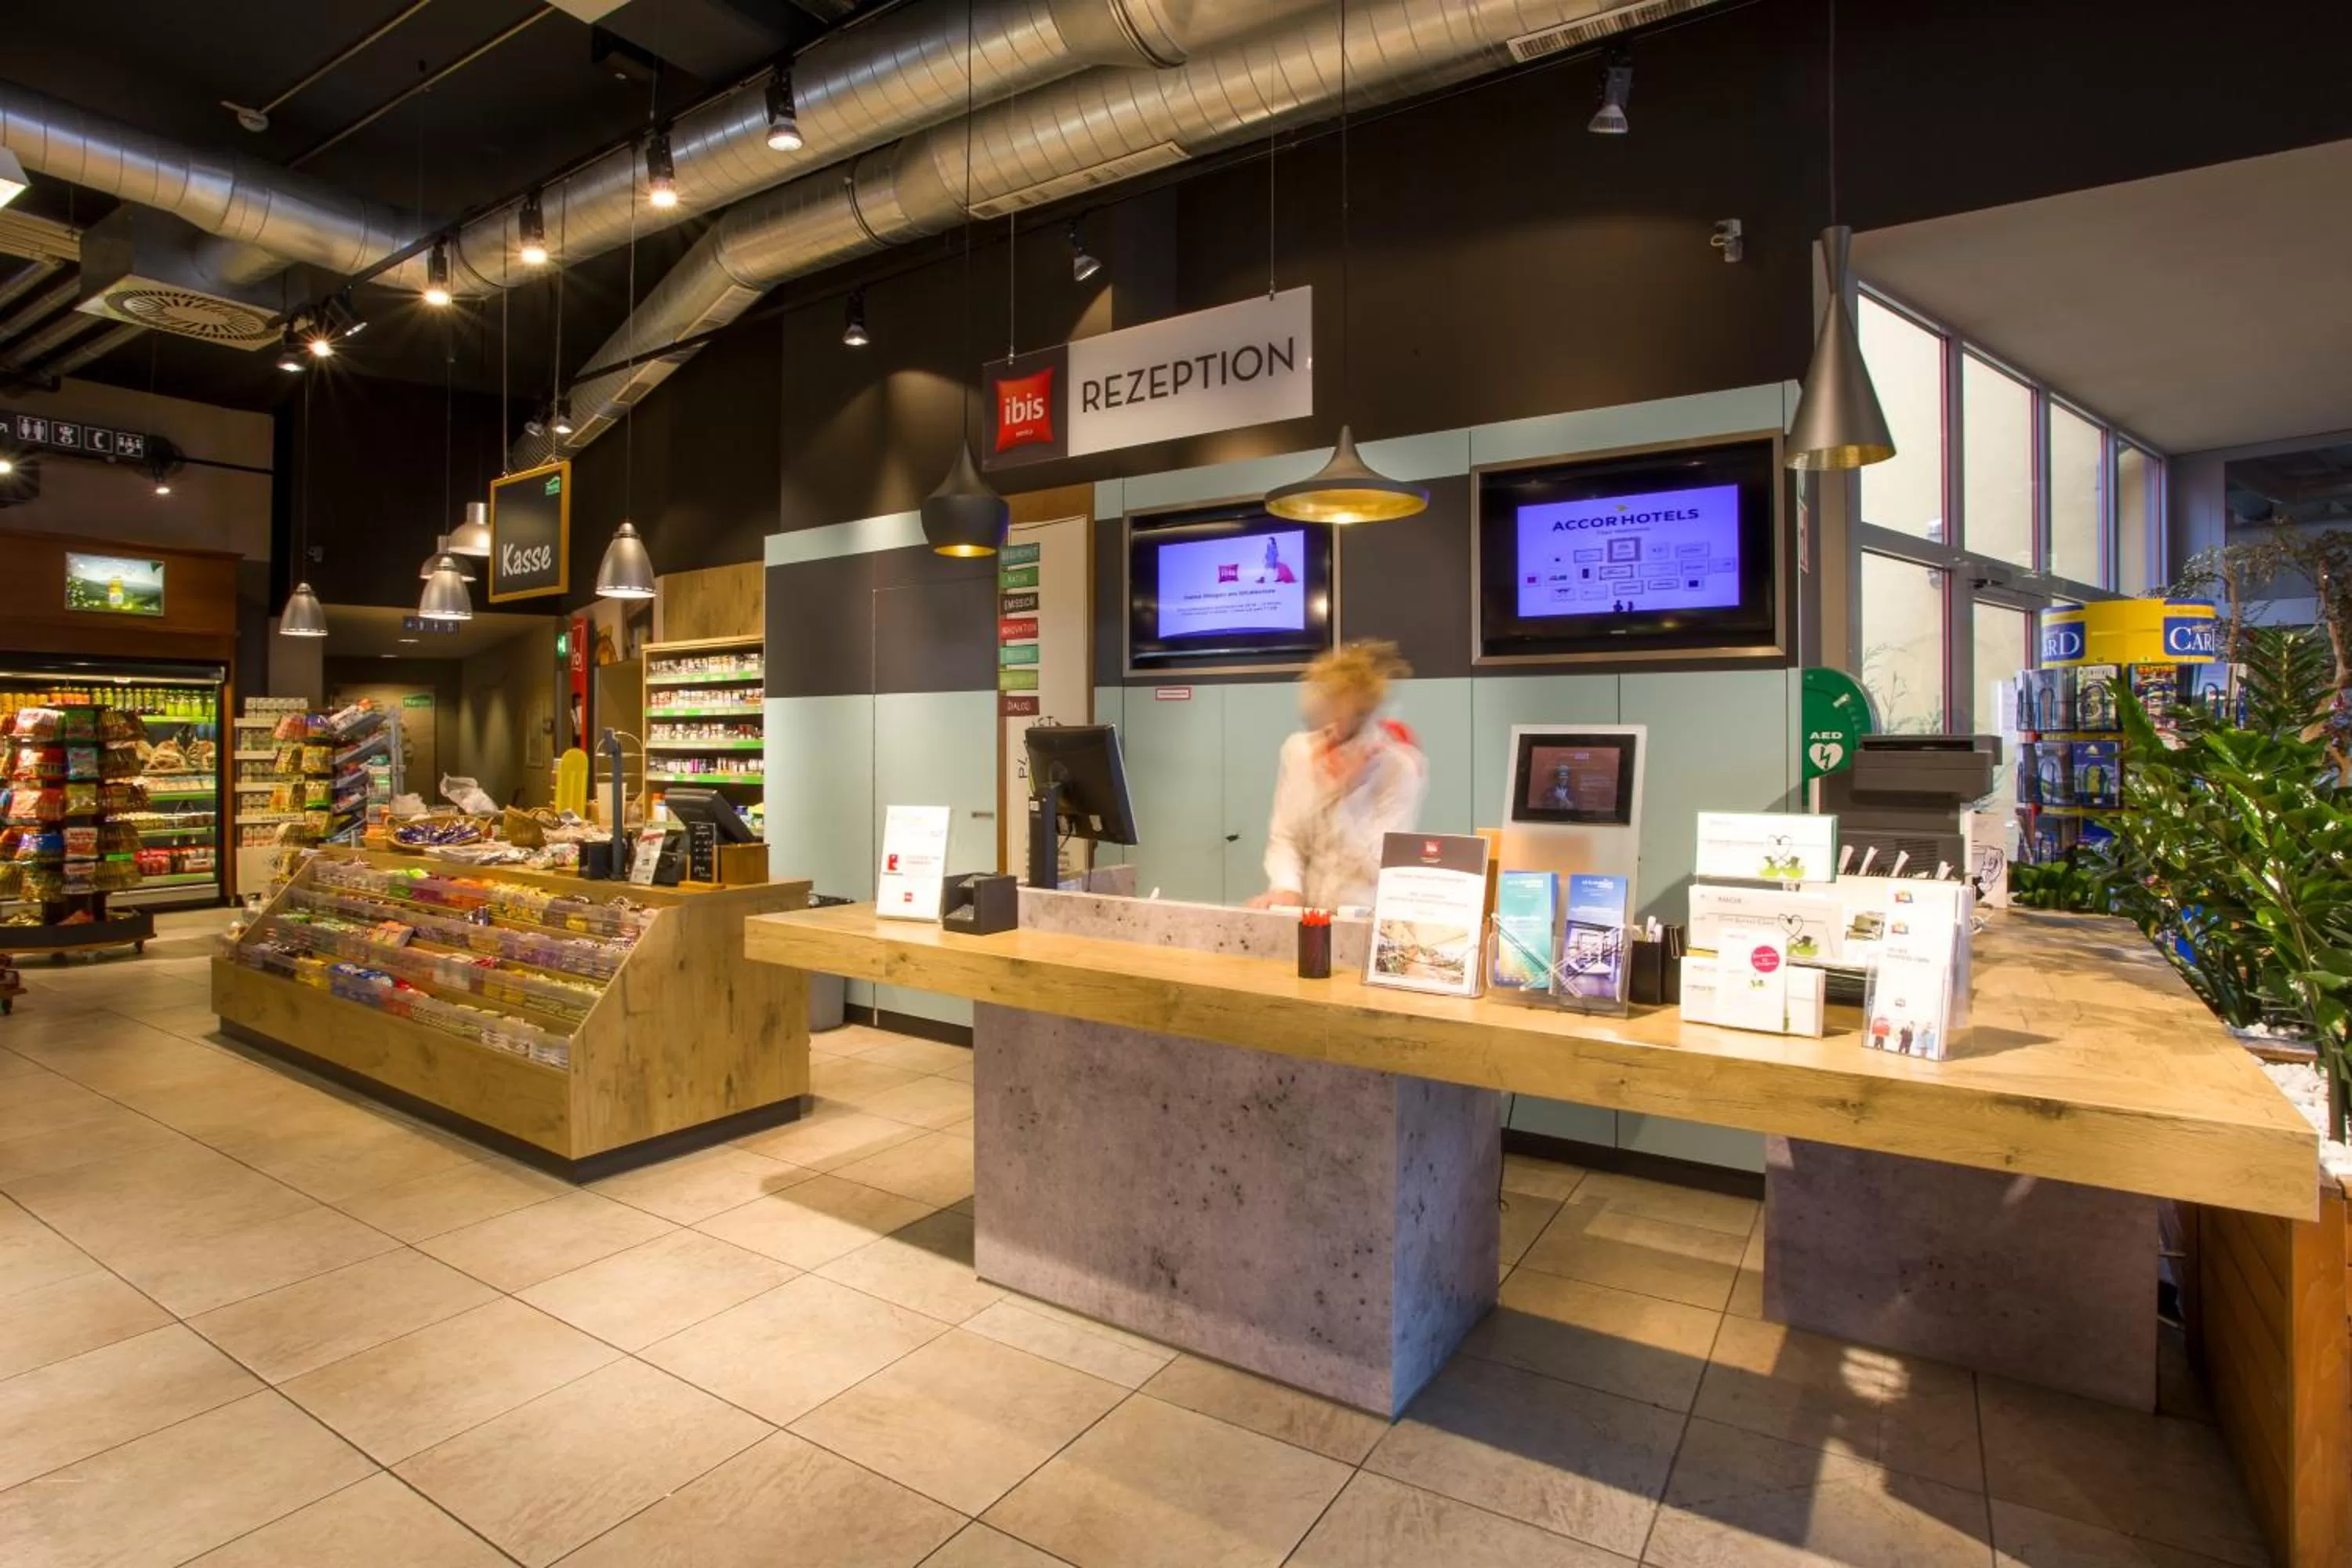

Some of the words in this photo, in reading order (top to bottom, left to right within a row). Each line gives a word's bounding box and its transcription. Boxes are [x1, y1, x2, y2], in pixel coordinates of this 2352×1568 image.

[1082, 336, 1294, 413] REZEPTION
[1004, 392, 1044, 426] ibis
[502, 543, 552, 577] Kasse
[2169, 626, 2216, 652] CAR
[1809, 731, 1843, 740] AED
